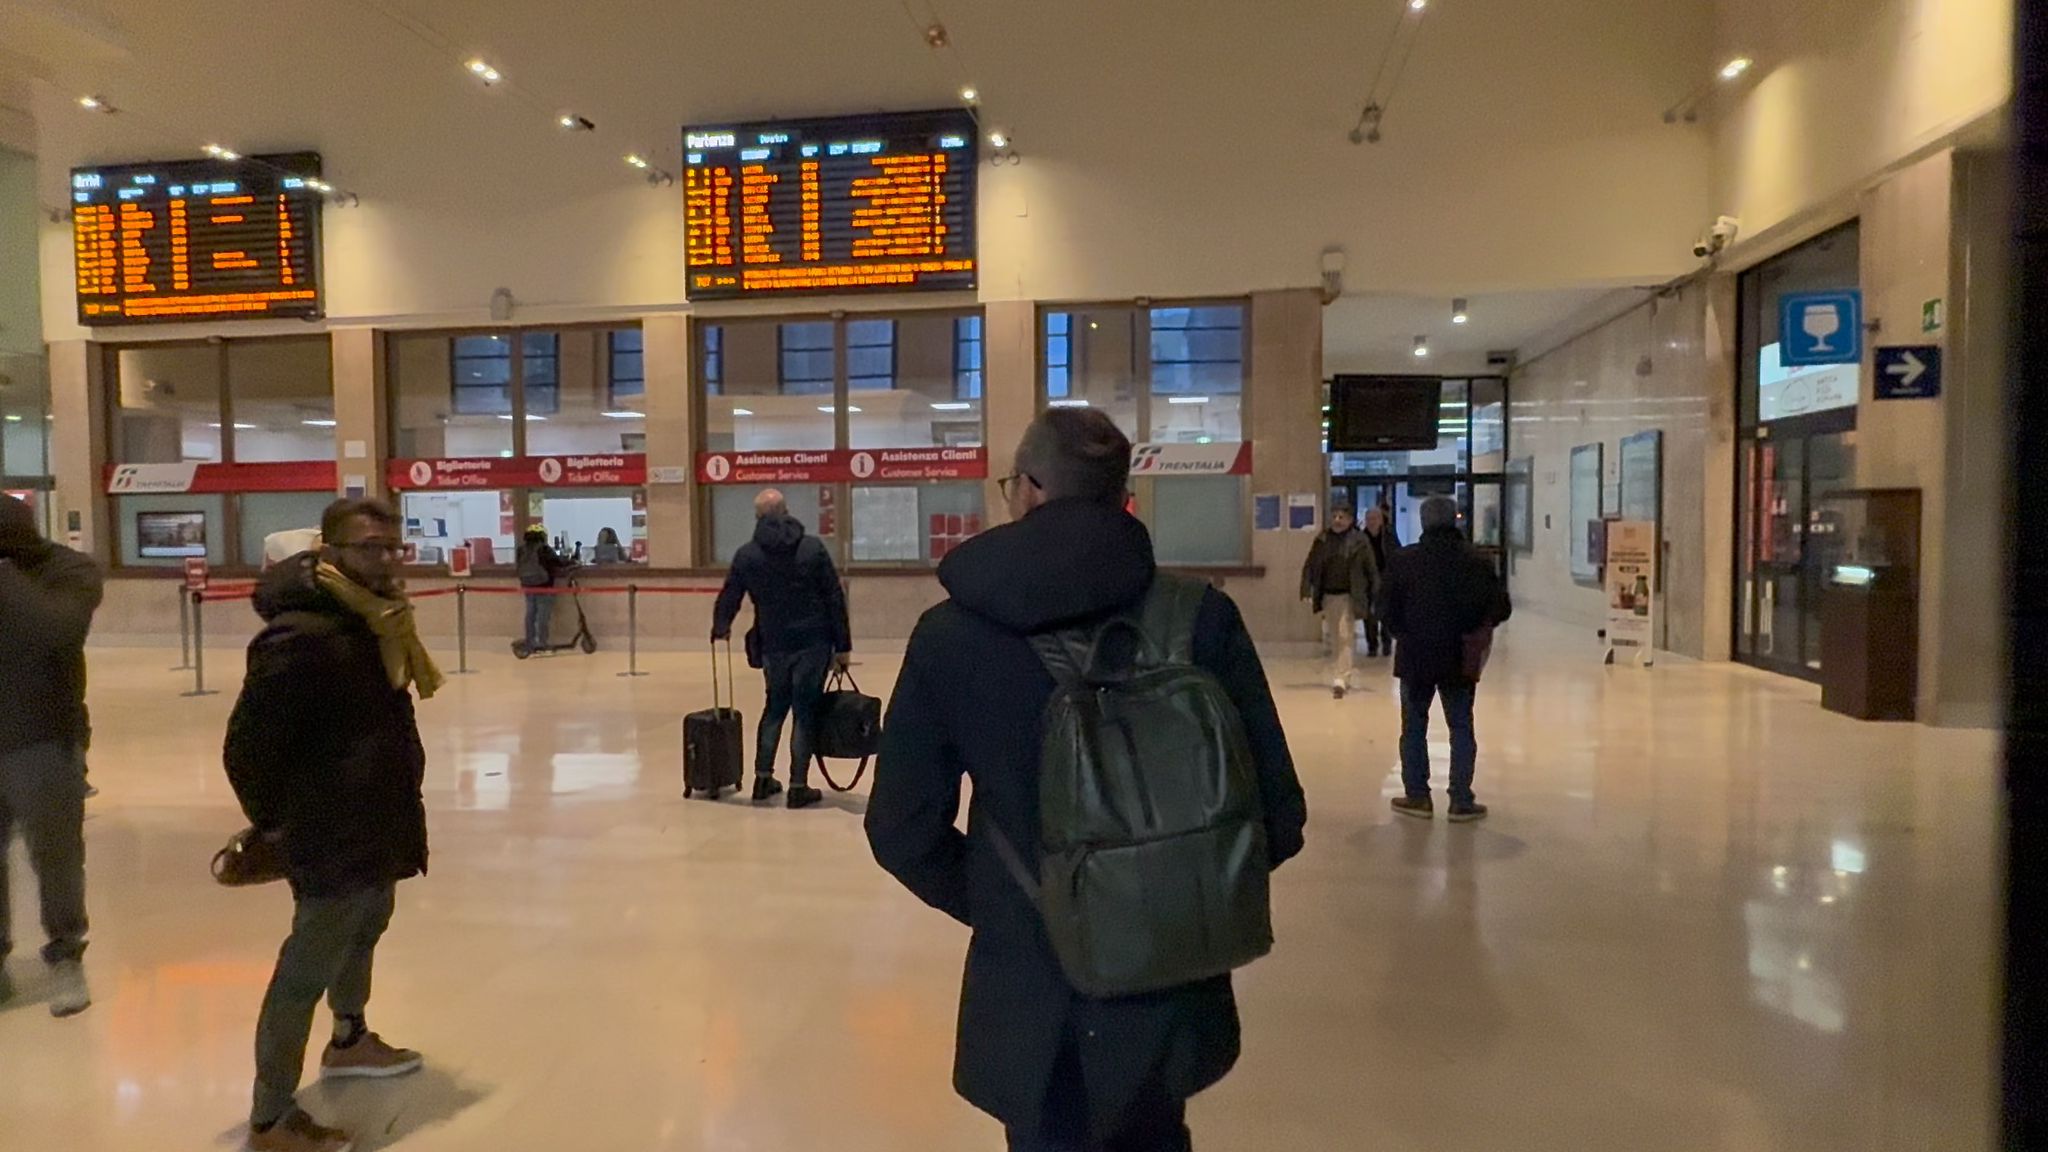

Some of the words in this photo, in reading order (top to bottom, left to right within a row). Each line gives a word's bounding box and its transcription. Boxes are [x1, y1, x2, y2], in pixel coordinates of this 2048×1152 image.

[736, 455, 791, 465] Assistenza
[793, 453, 828, 463] Clienti
[881, 451, 939, 461] Assistenza
[941, 449, 977, 460] Clienti
[880, 467, 922, 478] Customer
[924, 466, 958, 477] Service
[1159, 461, 1225, 471] TRENITALIA
[461, 474, 487, 485] Office
[568, 472, 592, 482] Ticket
[593, 471, 620, 482] Office
[736, 470, 776, 481] Customer
[777, 469, 810, 480] Service
